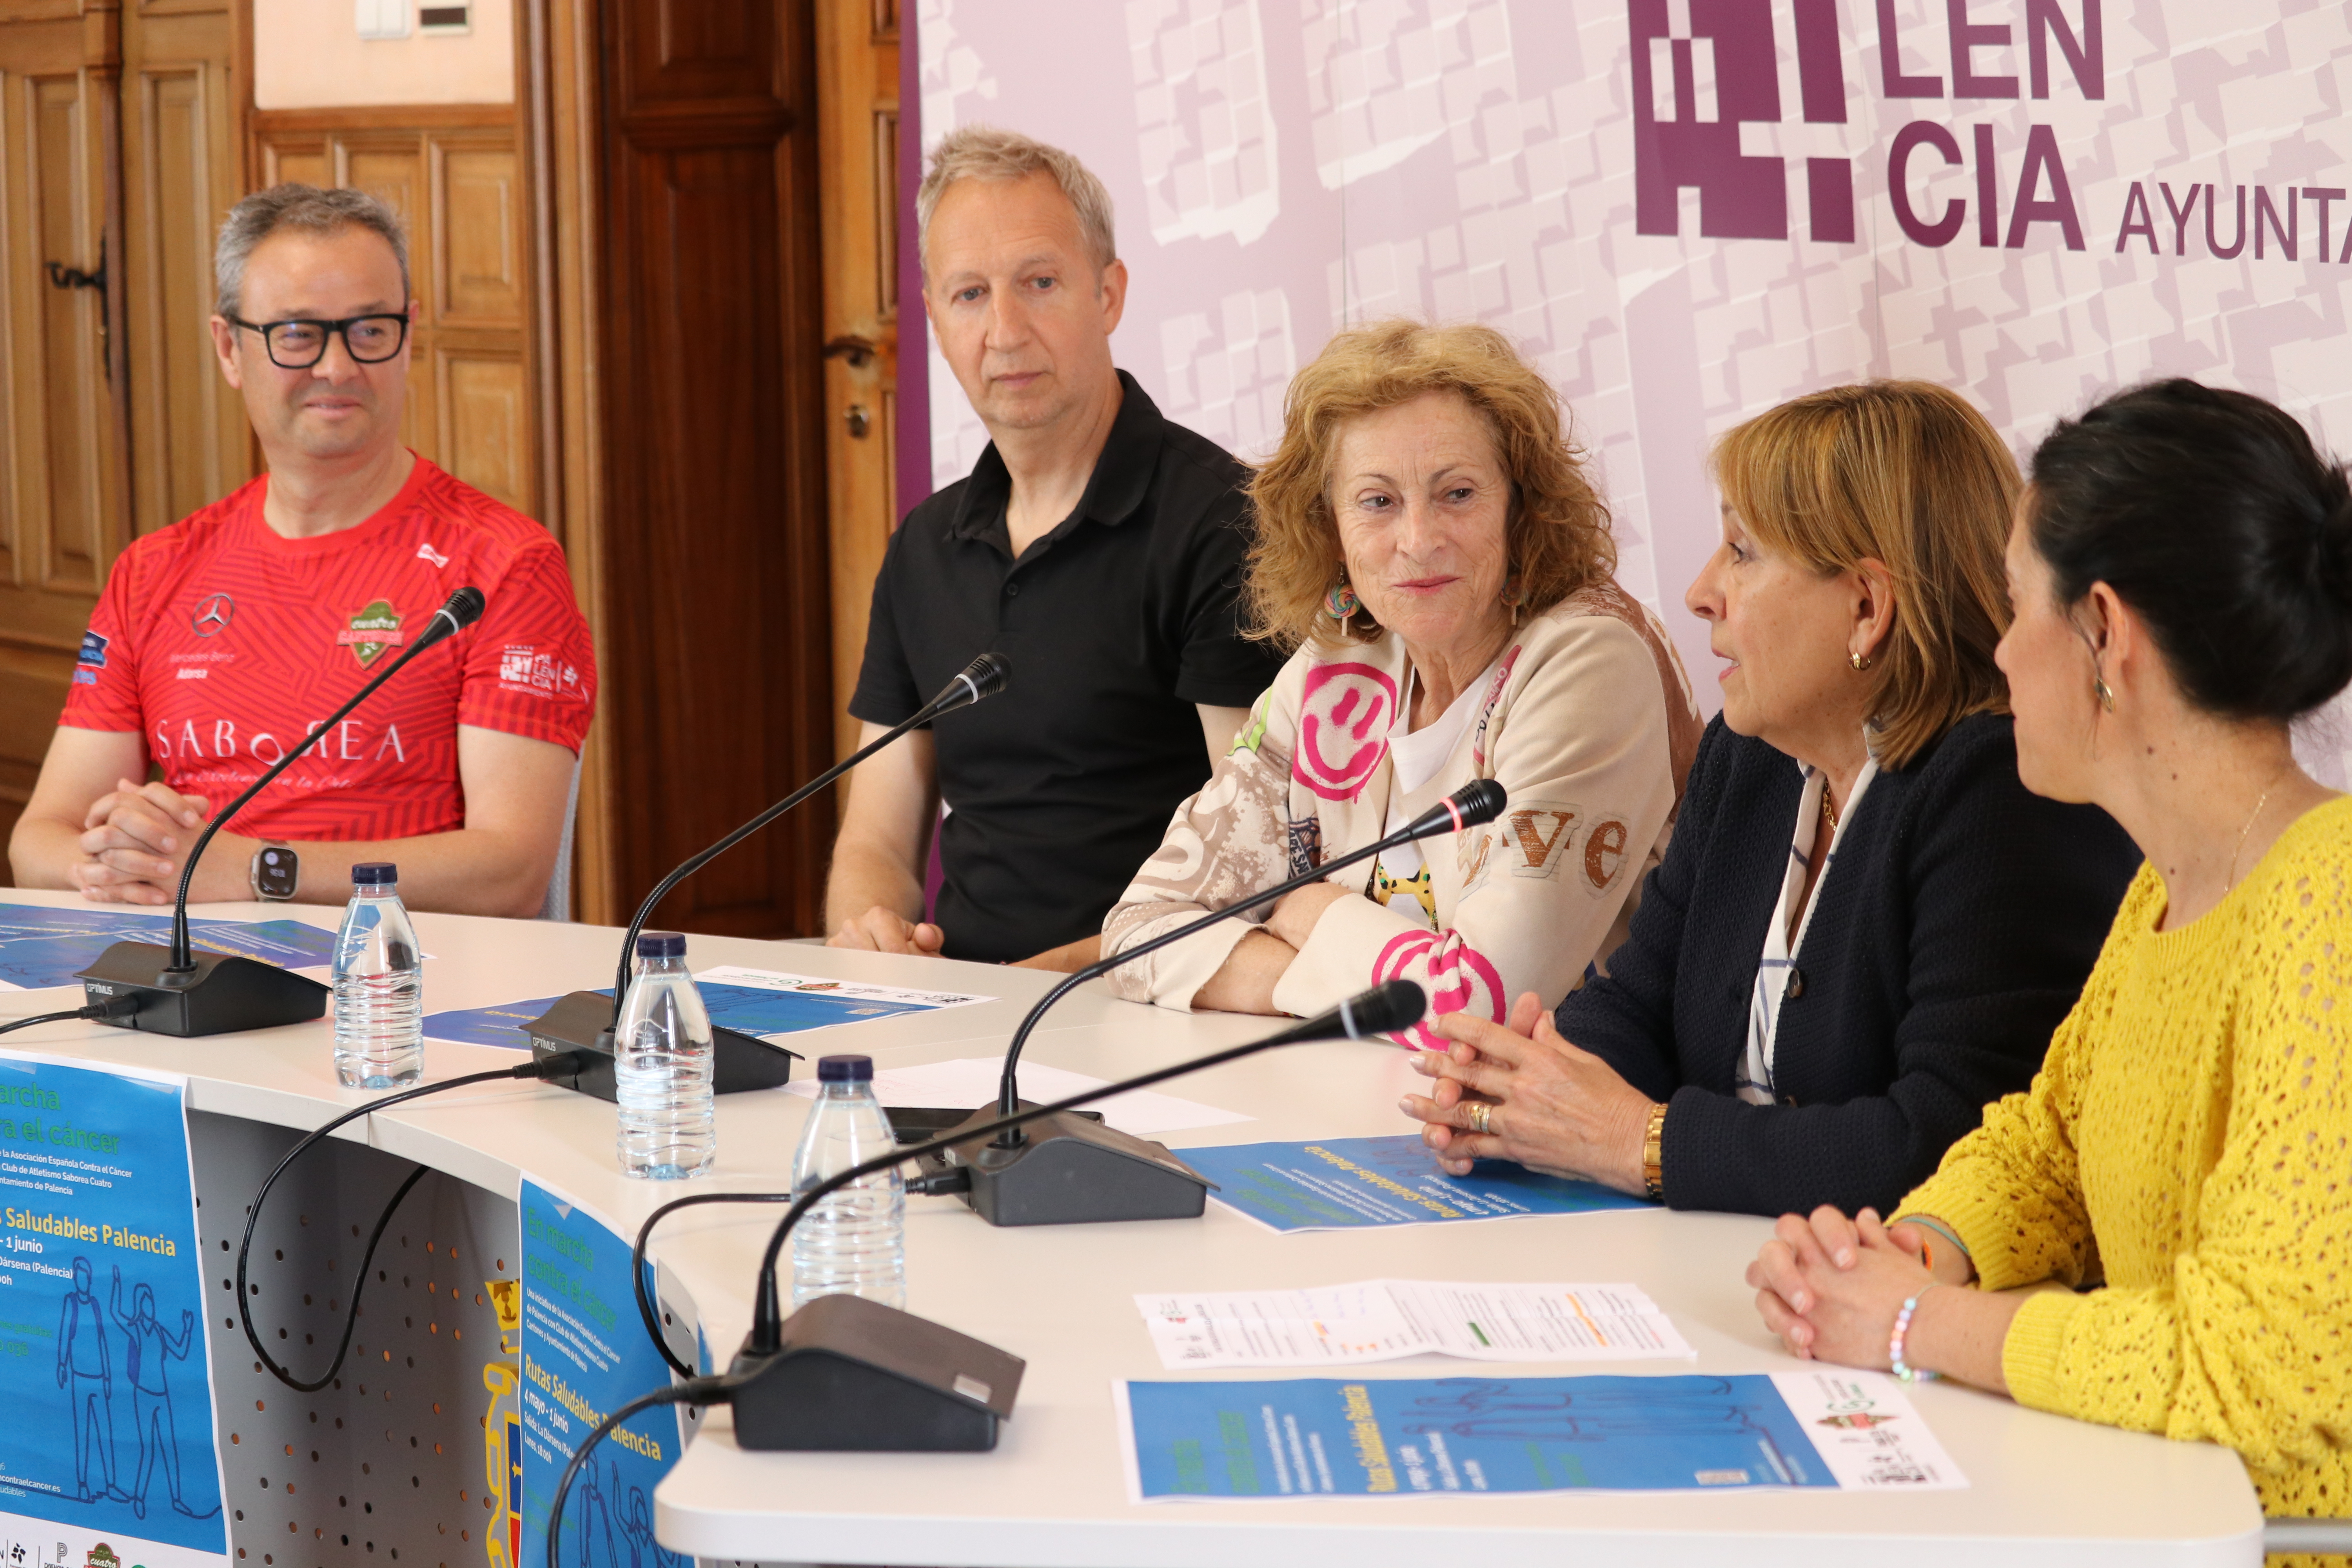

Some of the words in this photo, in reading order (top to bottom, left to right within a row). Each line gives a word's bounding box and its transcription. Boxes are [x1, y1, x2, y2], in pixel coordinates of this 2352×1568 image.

[1876, 0, 2105, 100] LEN
[1887, 120, 2086, 251] CIA
[2115, 181, 2352, 264] AYUNT
[87, 983, 113, 996] OPTIMUS
[532, 1036, 556, 1052] OPTIMUS
[22, 1117, 45, 1143] el
[49, 1121, 120, 1155] cáncer
[2, 1163, 18, 1172] Club
[19, 1165, 28, 1174] de
[29, 1167, 62, 1180] Atletismo
[62, 1172, 90, 1185] Saborea
[90, 1177, 113, 1189] Cuatro
[3, 1149, 9, 1158] la
[11, 1150, 47, 1163] Asociación
[48, 1156, 79, 1167] Española
[79, 1161, 101, 1173] Contra
[102, 1165, 108, 1174] el
[109, 1166, 132, 1178] Cáncer
[34, 1181, 44, 1191] de
[44, 1182, 73, 1195] Palencia
[5, 1207, 98, 1242] Saludables
[102, 1225, 176, 1257] Palencia
[6, 1236, 13, 1249] 1
[13, 1235, 43, 1254] junio
[528, 1207, 544, 1241] En
[547, 1224, 594, 1272] marcha
[32, 1261, 73, 1279] (Palencia)
[528, 1253, 568, 1296] contra
[571, 1276, 583, 1306] el
[584, 1288, 617, 1332] cáncer
[526, 1304, 532, 1314] de
[532, 1306, 548, 1325] Palencia
[555, 1322, 565, 1336] Club
[564, 1329, 570, 1340] de
[570, 1332, 585, 1352] Atletismo
[584, 1345, 596, 1363] Saborea
[595, 1356, 609, 1372] Cuatro
[526, 1319, 544, 1338] Cantones
[543, 1333, 547, 1342] y
[546, 1332, 572, 1358] Ayuntamiento
[570, 1351, 575, 1361] de
[575, 1353, 588, 1373] Palencia
[527, 1287, 535, 1300] Una
[535, 1292, 552, 1312] iniciativa
[552, 1304, 557, 1314] de
[557, 1307, 562, 1318] la
[561, 1310, 581, 1331] Asociación
[580, 1323, 594, 1343] Española
[593, 1335, 604, 1352] Contra
[603, 1346, 608, 1356] el
[606, 1347, 621, 1365] Cáncer
[524, 1388, 529, 1403] 4
[529, 1391, 545, 1416] mayo
[549, 1408, 553, 1422] 1
[552, 1407, 568, 1434] junio
[525, 1354, 551, 1393] Rutas
[552, 1374, 601, 1430] Saludables
[524, 1411, 538, 1430] Salida:
[537, 1423, 544, 1437] La
[544, 1427, 562, 1452] Dársena
[524, 1431, 537, 1454] Lunes,
[537, 1445, 552, 1465] 18:00h
